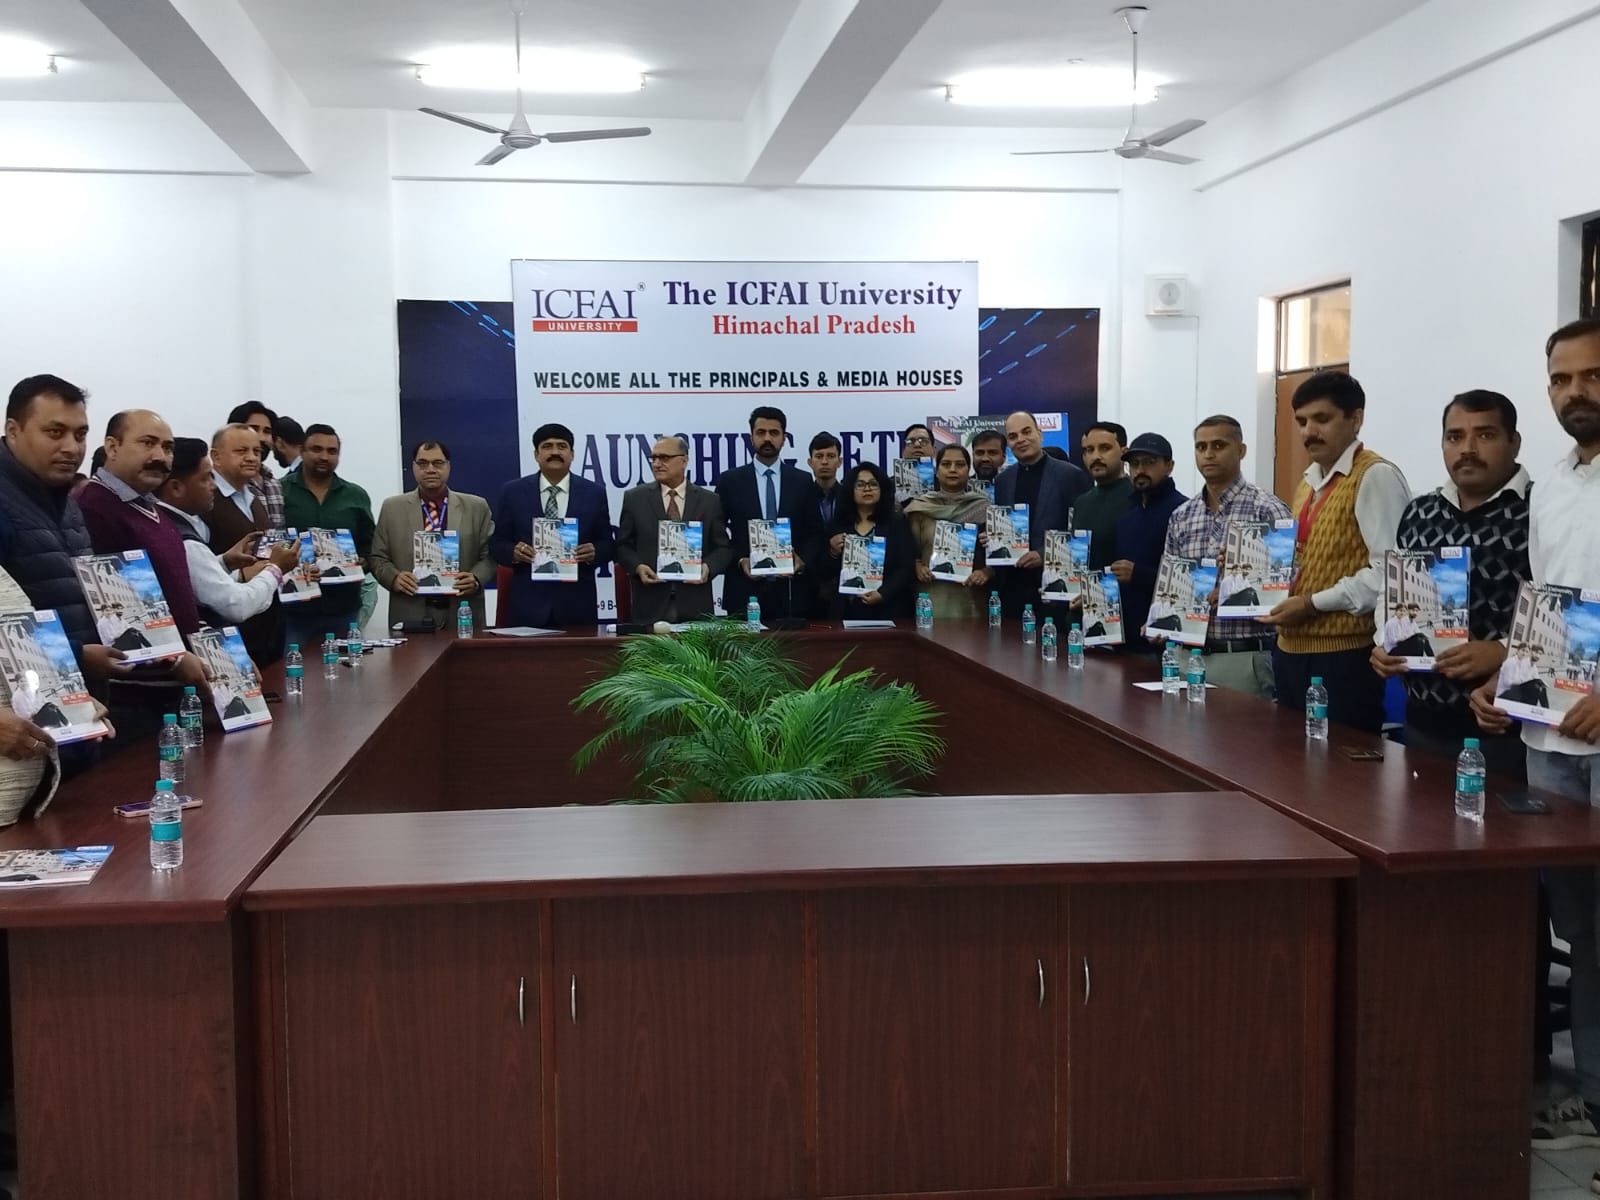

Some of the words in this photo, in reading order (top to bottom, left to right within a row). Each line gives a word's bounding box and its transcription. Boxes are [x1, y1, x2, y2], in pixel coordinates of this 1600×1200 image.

[531, 289, 638, 319] ICFAI
[663, 281, 717, 305] The
[726, 281, 809, 306] ICFAI
[818, 281, 963, 310] University
[548, 321, 623, 331] UNIVERSITY
[713, 314, 819, 334] Himachal
[827, 314, 916, 334] Pradesh
[534, 371, 621, 389] WELCOME
[629, 371, 661, 388] ALL
[668, 371, 702, 388] THE
[709, 370, 810, 388] PRINCIPALS
[817, 371, 828, 387] &
[837, 370, 889, 387] MEDIA
[896, 369, 964, 386] HOUSES
[581, 432, 798, 489] AUNHIN
